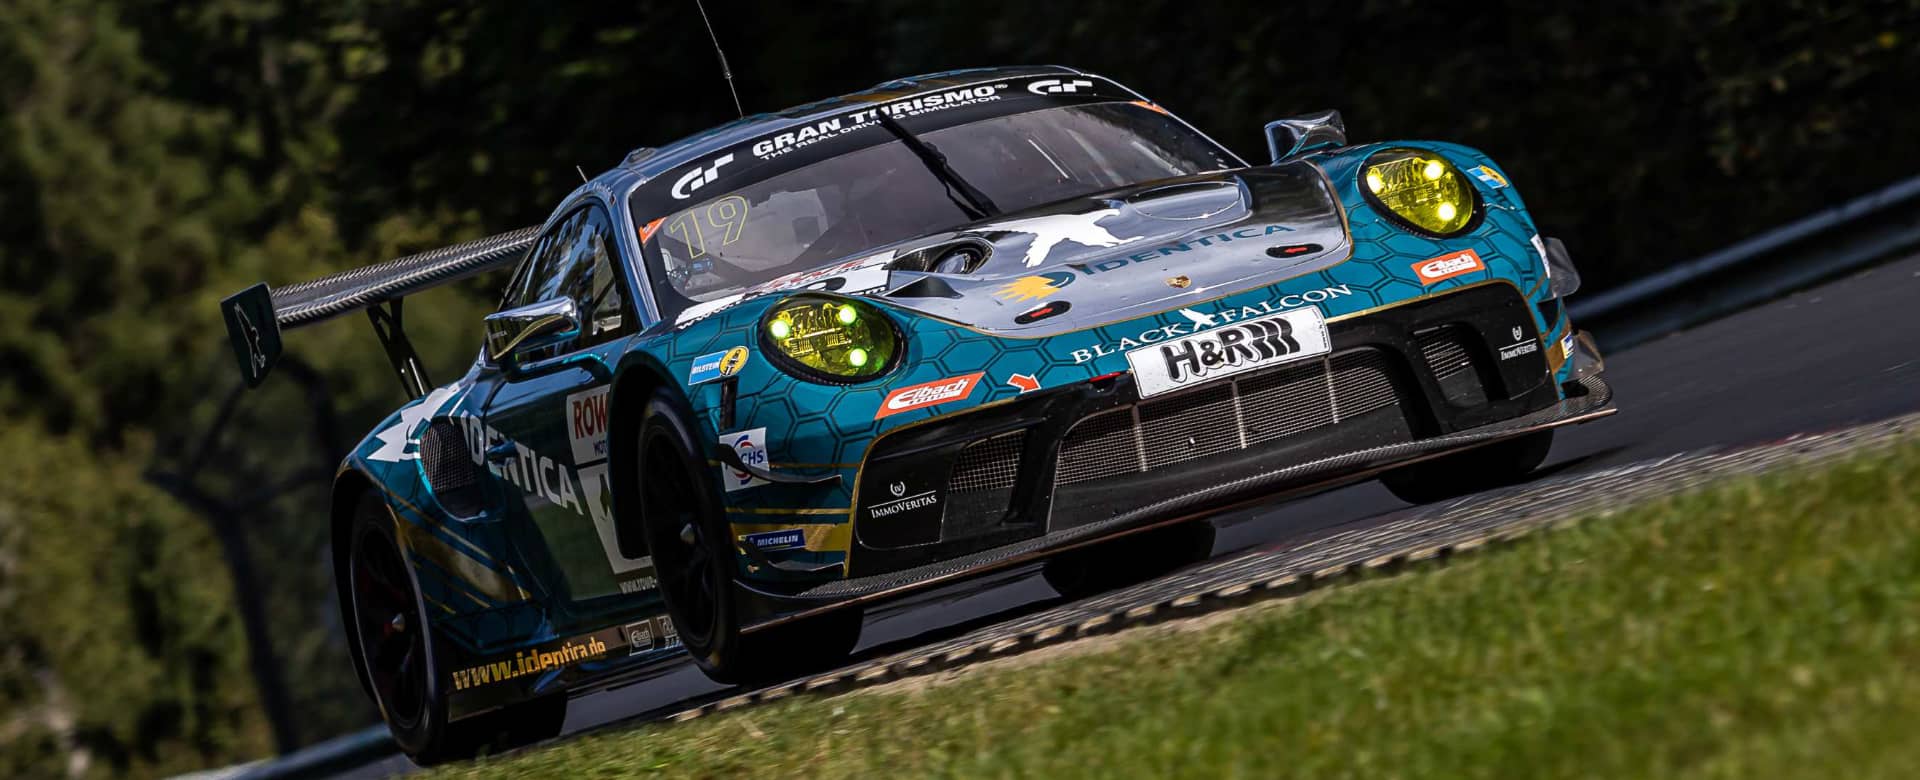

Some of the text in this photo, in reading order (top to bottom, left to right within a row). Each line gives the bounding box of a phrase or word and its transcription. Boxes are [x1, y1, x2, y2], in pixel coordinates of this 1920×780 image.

[752, 117, 842, 157] GRAN
[760, 95, 1001, 160] THE REAL DRIVIG SIMULATOR
[669, 195, 748, 259] 19
[1076, 224, 1296, 276] IDENTICA
[1070, 284, 1353, 365] BLACK FALCON
[572, 391, 609, 440] ROW
[887, 378, 970, 410] Eibach
[757, 534, 799, 547] MICHELIN
